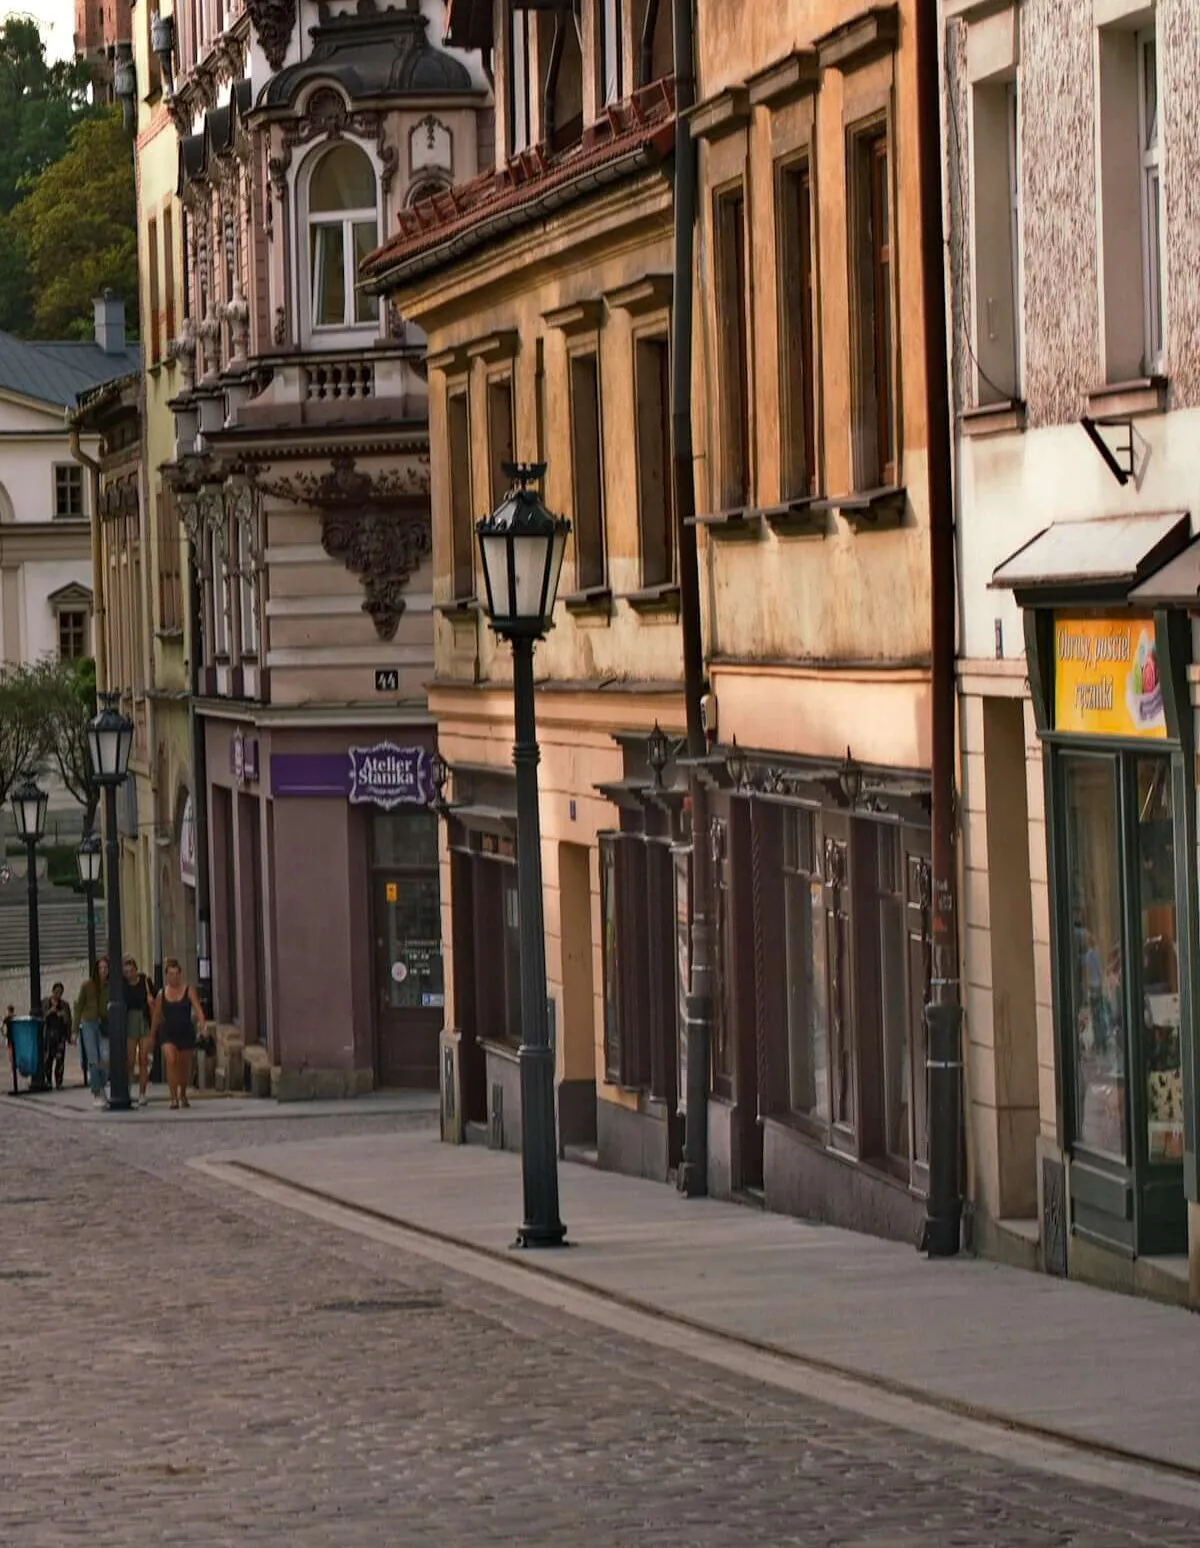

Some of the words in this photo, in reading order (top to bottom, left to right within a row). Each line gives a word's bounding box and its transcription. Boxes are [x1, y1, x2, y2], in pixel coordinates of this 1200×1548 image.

[1094, 627, 1131, 669] pościel
[378, 672, 396, 690] 44
[1074, 673, 1113, 718] ręczniki
[363, 755, 412, 773] Atelier
[358, 767, 414, 785] Stanika
